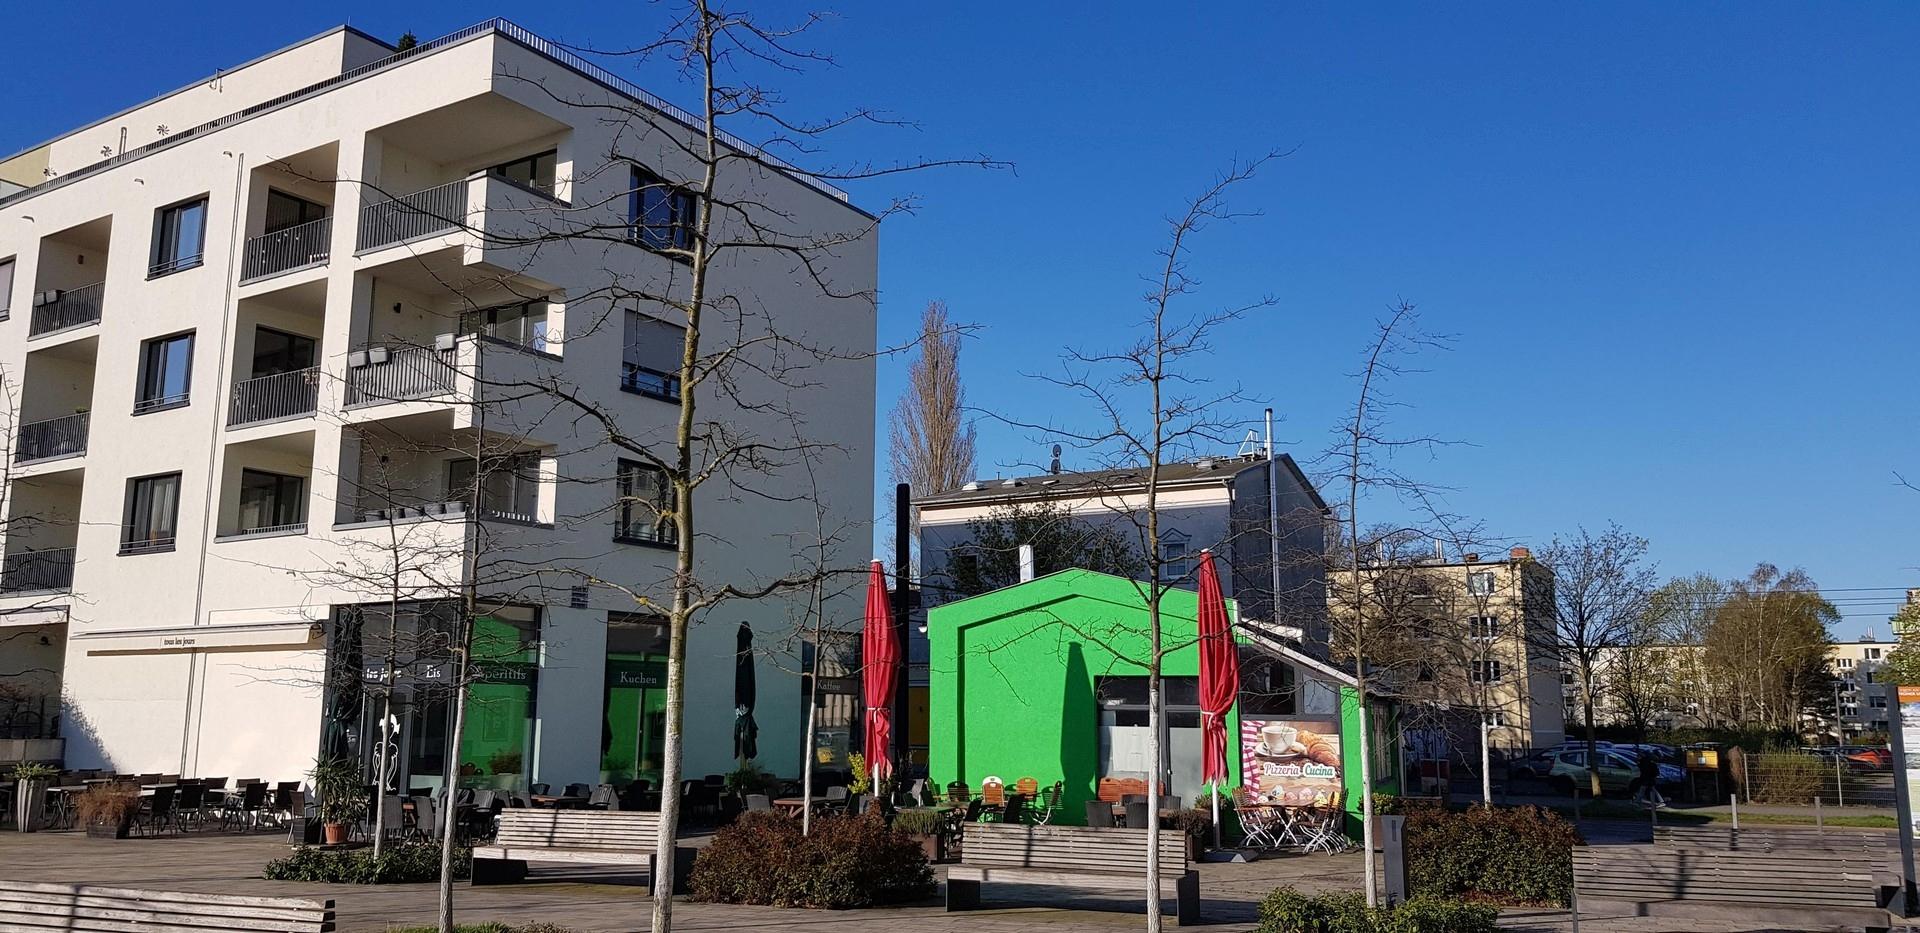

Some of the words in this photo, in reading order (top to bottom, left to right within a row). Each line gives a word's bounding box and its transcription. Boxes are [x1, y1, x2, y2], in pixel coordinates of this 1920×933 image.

[182, 637, 195, 647] jours
[379, 667, 402, 682] jors
[426, 664, 441, 678] Eis
[620, 671, 657, 684] Kuchen
[817, 680, 841, 690] Kaffee
[1264, 763, 1300, 776] Pizzeria
[1304, 764, 1333, 776] Cucina
